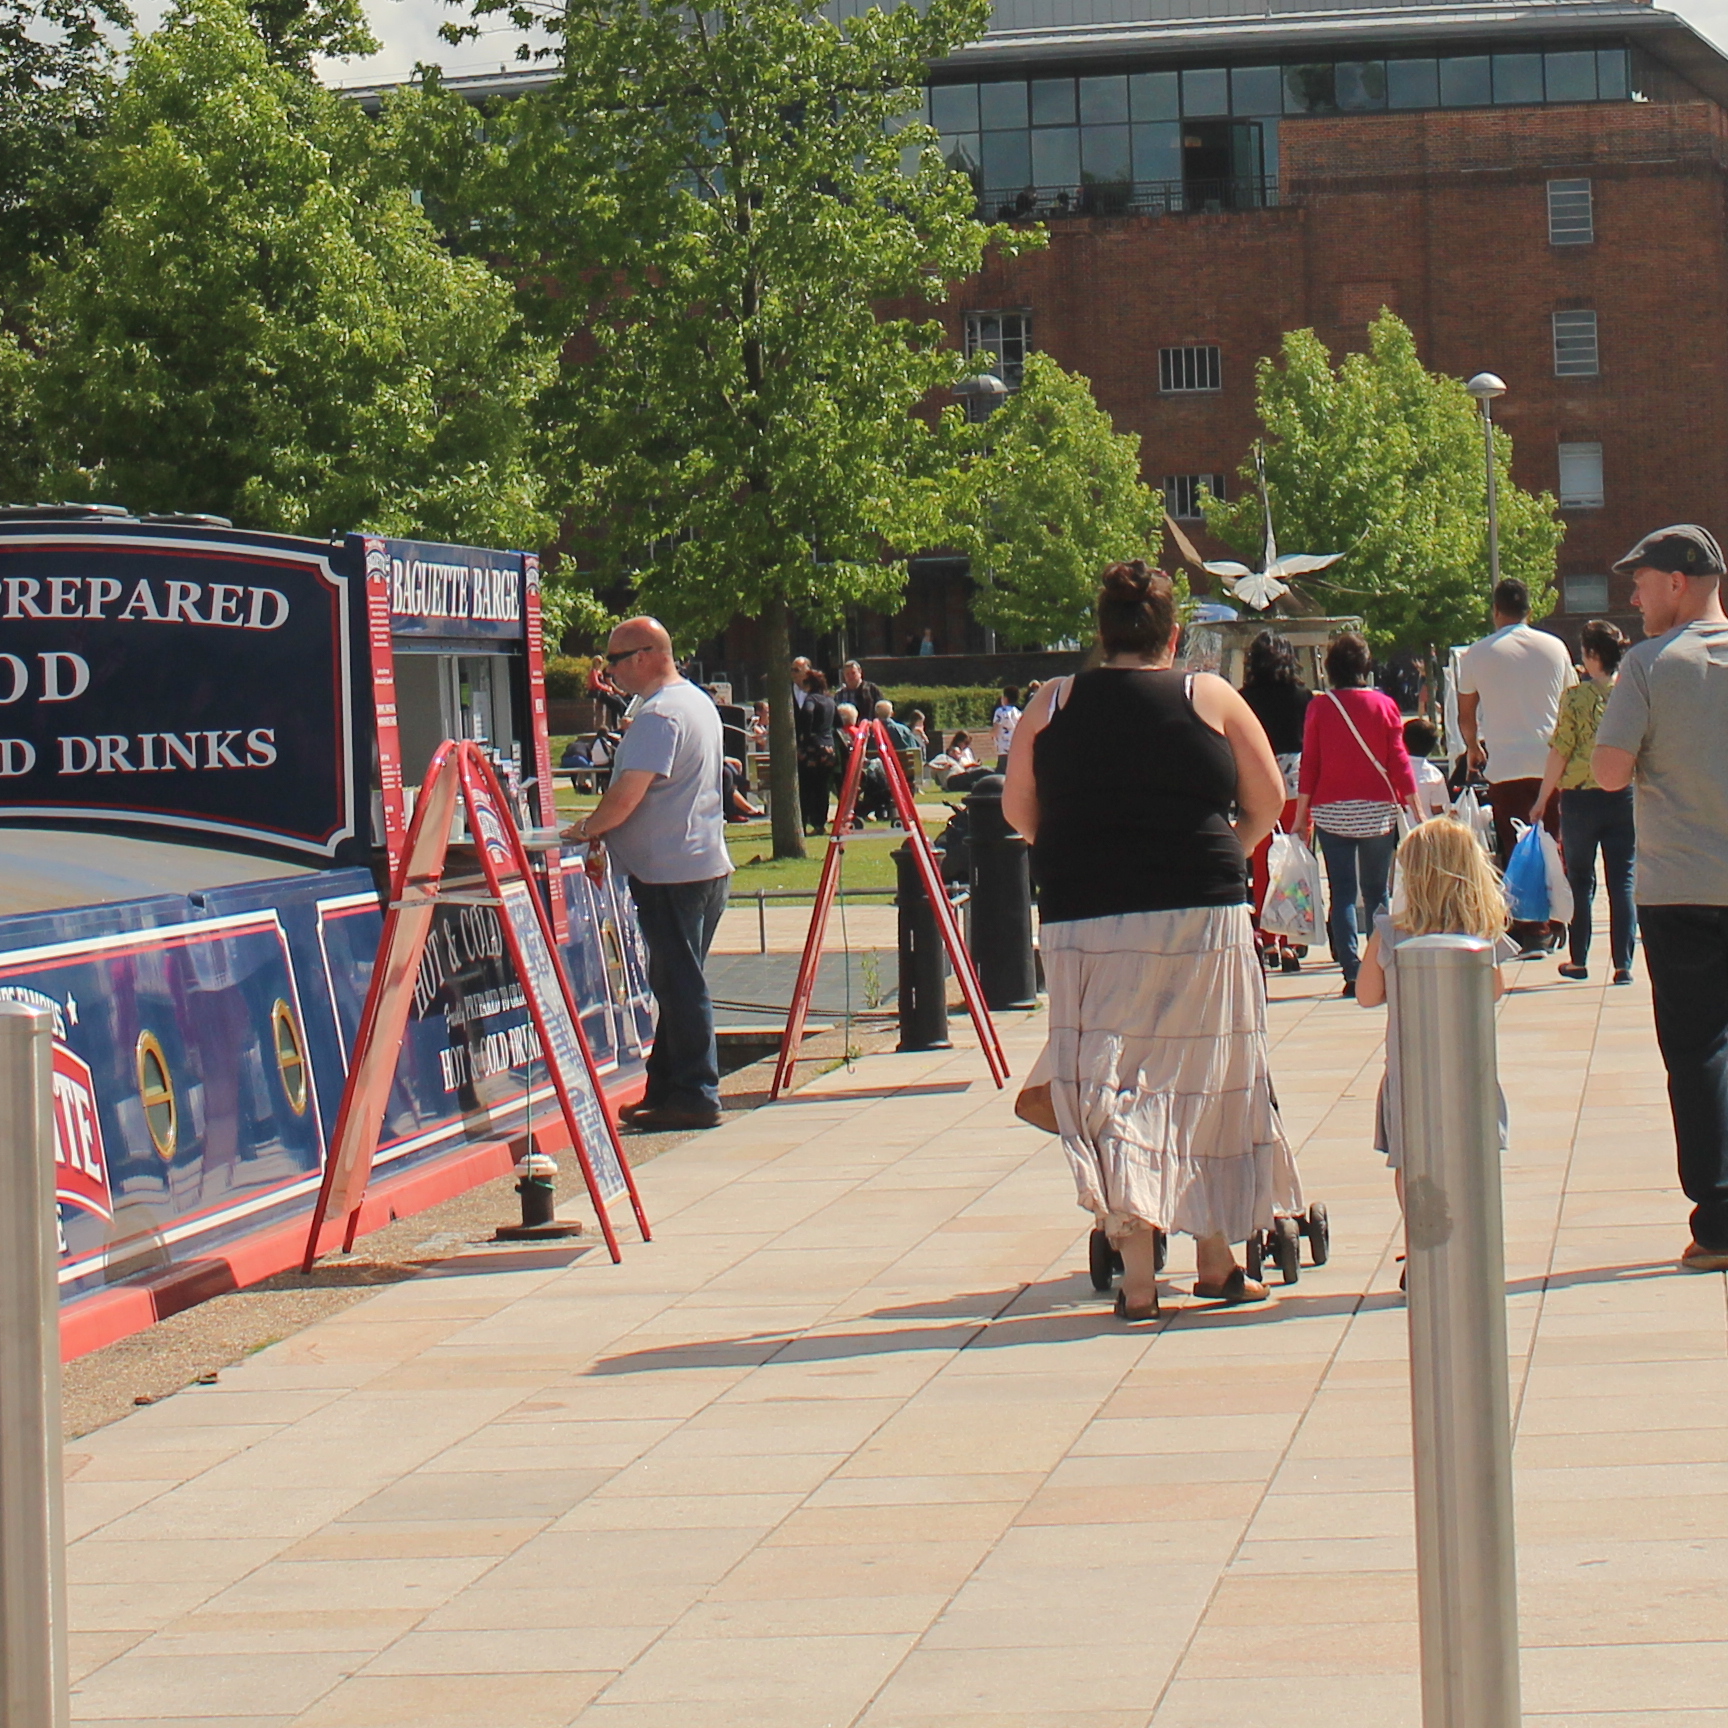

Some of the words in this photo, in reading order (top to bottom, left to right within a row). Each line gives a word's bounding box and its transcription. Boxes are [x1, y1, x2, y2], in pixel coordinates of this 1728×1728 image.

[391, 558, 470, 620] BAGUETTE
[472, 566, 521, 622] BARGE
[56, 728, 278, 775] DRINKS
[443, 919, 463, 973] &
[460, 904, 503, 959] COLD
[440, 1045, 468, 1092] HOT
[480, 1032, 509, 1077] COLD
[508, 1021, 545, 1068] DRIN
